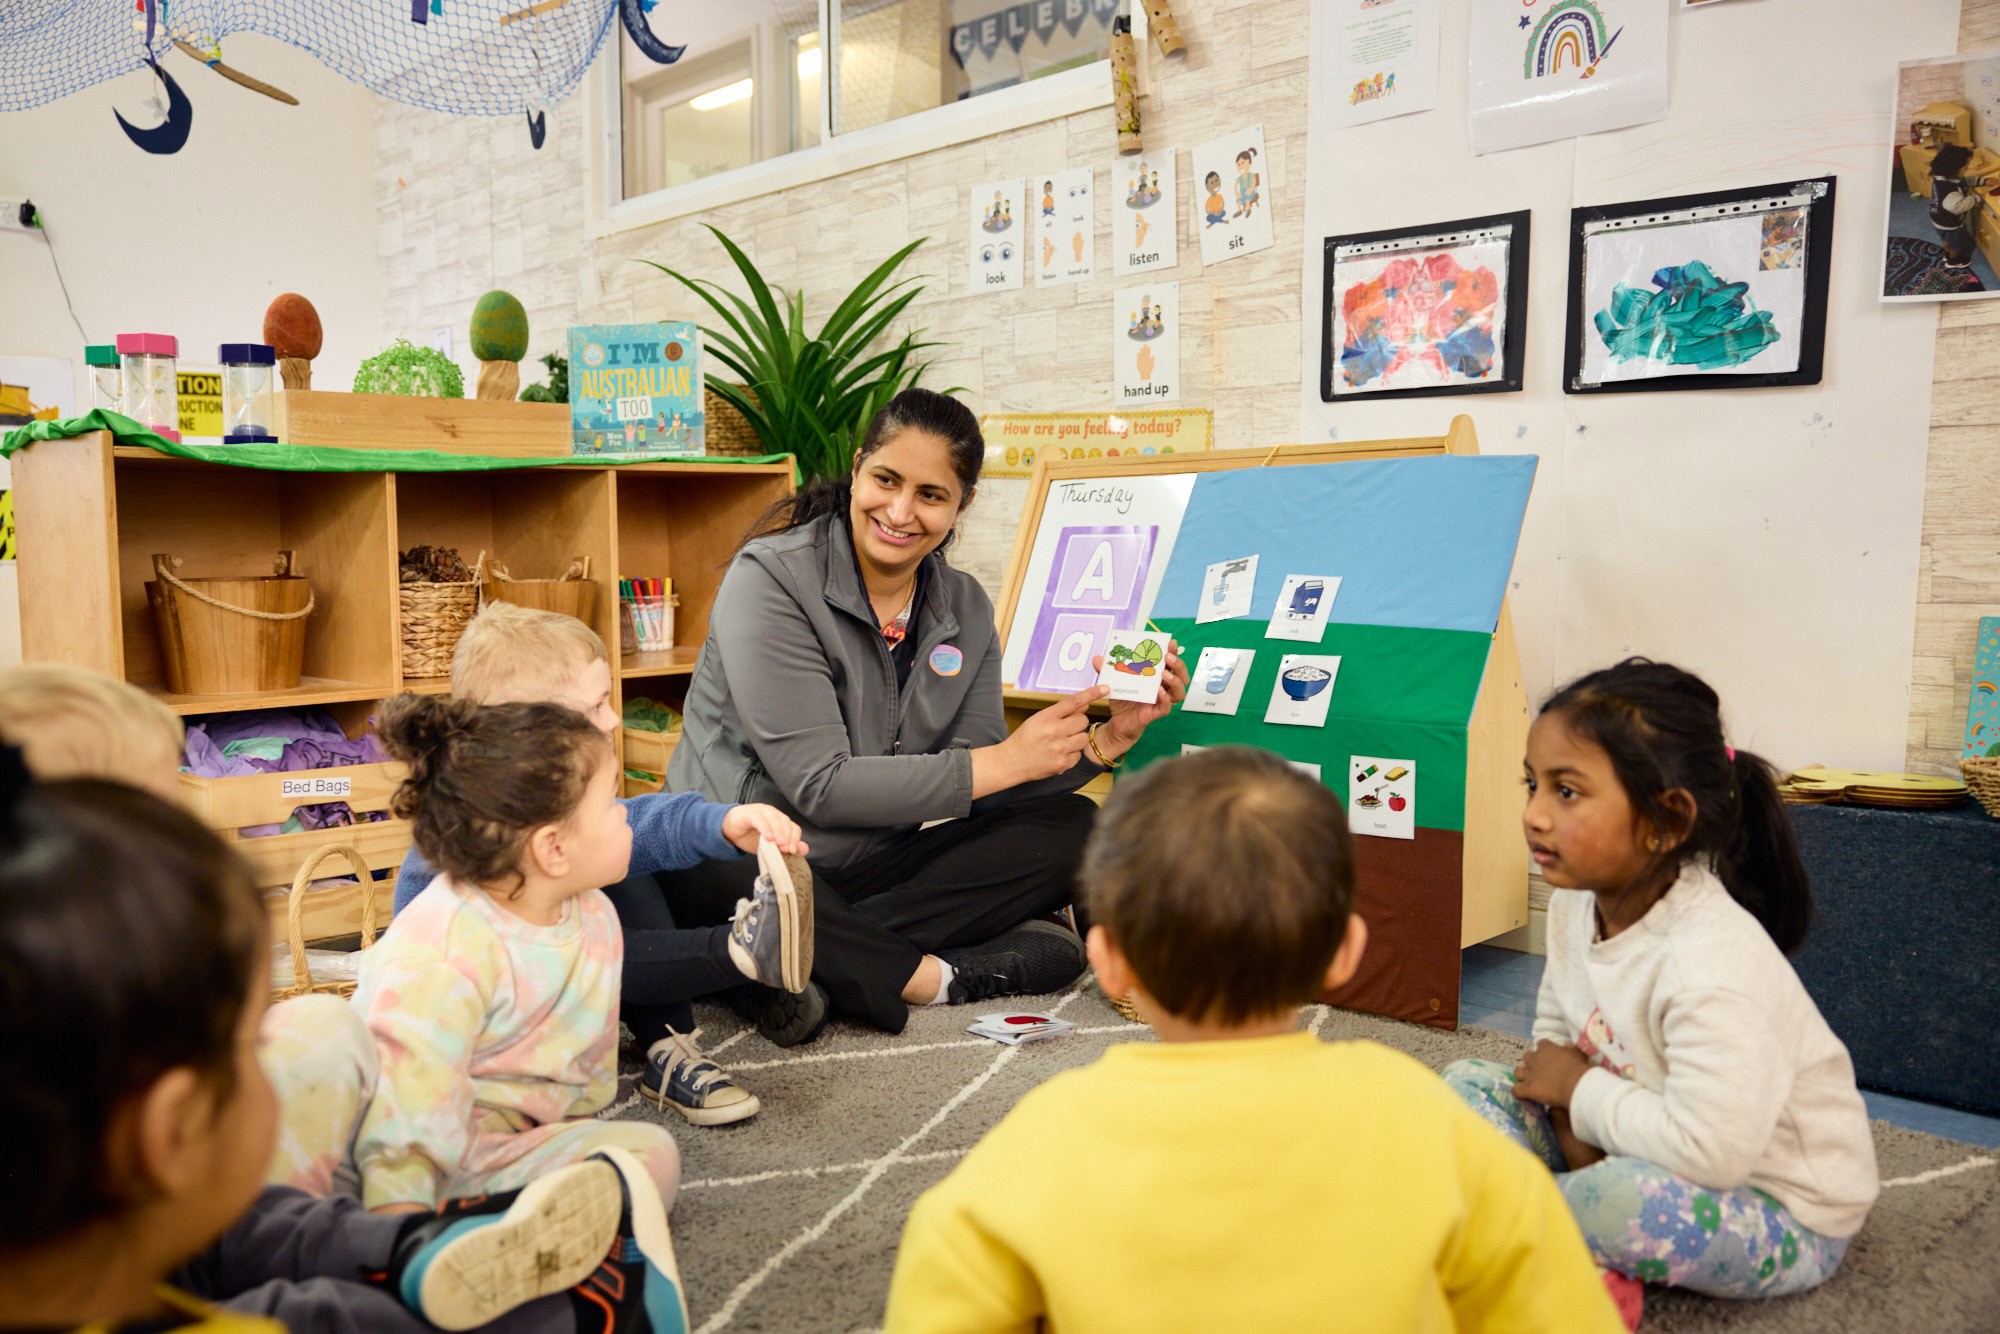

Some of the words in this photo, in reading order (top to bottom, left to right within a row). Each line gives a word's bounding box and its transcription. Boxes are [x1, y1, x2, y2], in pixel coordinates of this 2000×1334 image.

[1228, 235, 1245, 250] sit
[1129, 251, 1160, 266] listen
[986, 271, 1006, 284] look
[608, 342, 660, 365] I'M
[177, 376, 221, 395] TION
[581, 366, 691, 400] AUSTRALIAN
[1124, 382, 1151, 397] hand
[1154, 384, 1169, 397] up
[177, 400, 223, 413] UCTION
[620, 399, 649, 418] TOO
[1003, 421, 1030, 435] How
[1033, 423, 1054, 435] are
[1058, 422, 1080, 439] you
[1083, 419, 1129, 439] feelg
[1132, 418, 1182, 438] today?
[1059, 482, 1134, 515] Thursday
[1071, 539, 1114, 602] A
[1057, 630, 1095, 673] a
[283, 780, 311, 794] Bed
[315, 779, 350, 795] Bags
